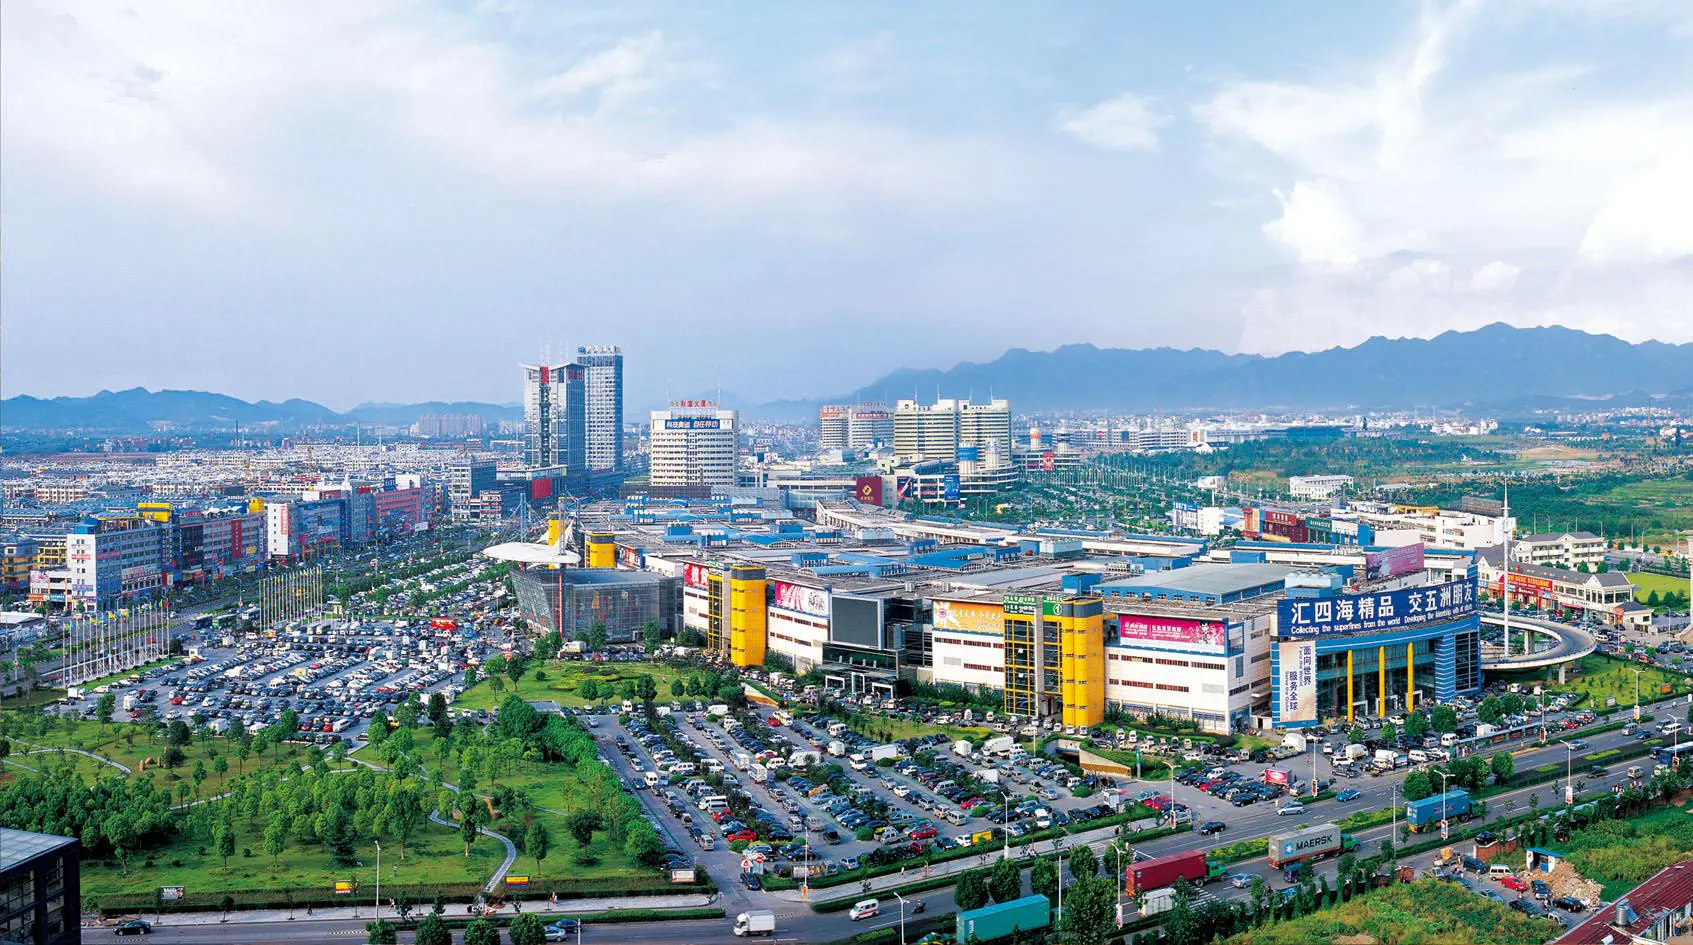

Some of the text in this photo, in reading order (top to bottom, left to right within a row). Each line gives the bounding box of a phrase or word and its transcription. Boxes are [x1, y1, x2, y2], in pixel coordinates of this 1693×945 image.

[1291, 582, 1473, 624] 汇四海精品 交五洲朋友
[1291, 626, 1319, 635] Collecting
[1322, 624, 1331, 632] the
[1334, 622, 1361, 632] superfines
[1364, 620, 1375, 628] from
[1377, 619, 1385, 627] the
[1388, 617, 1400, 626] world
[1404, 614, 1426, 623] Developing
[1304, 645, 1312, 686] 面向世界
[1290, 671, 1298, 711] 服务全球
[1296, 834, 1333, 851] MAERSK
